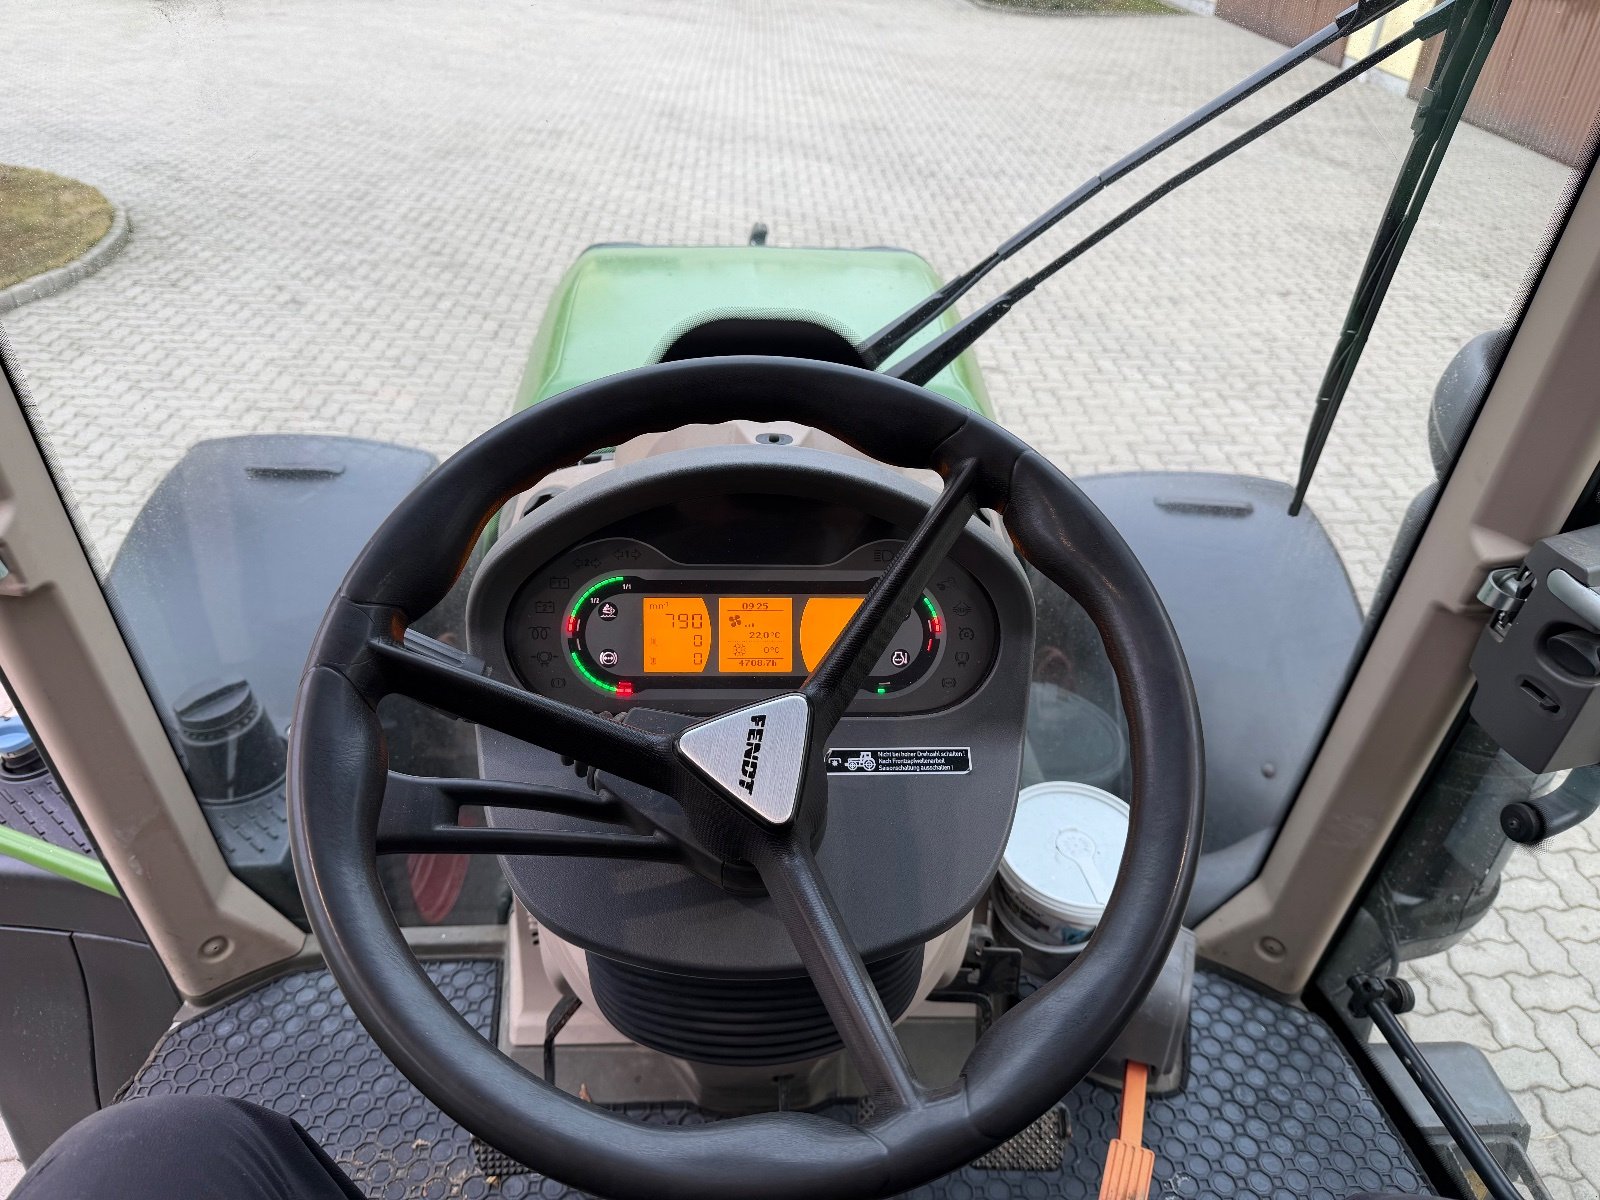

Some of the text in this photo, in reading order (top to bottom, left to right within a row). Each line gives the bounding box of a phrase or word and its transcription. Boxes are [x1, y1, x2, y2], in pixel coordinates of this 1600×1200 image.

[665, 613, 703, 629] 790
[693, 634, 703, 647] 0
[693, 652, 703, 665] 0
[738, 714, 767, 796] FENDT
